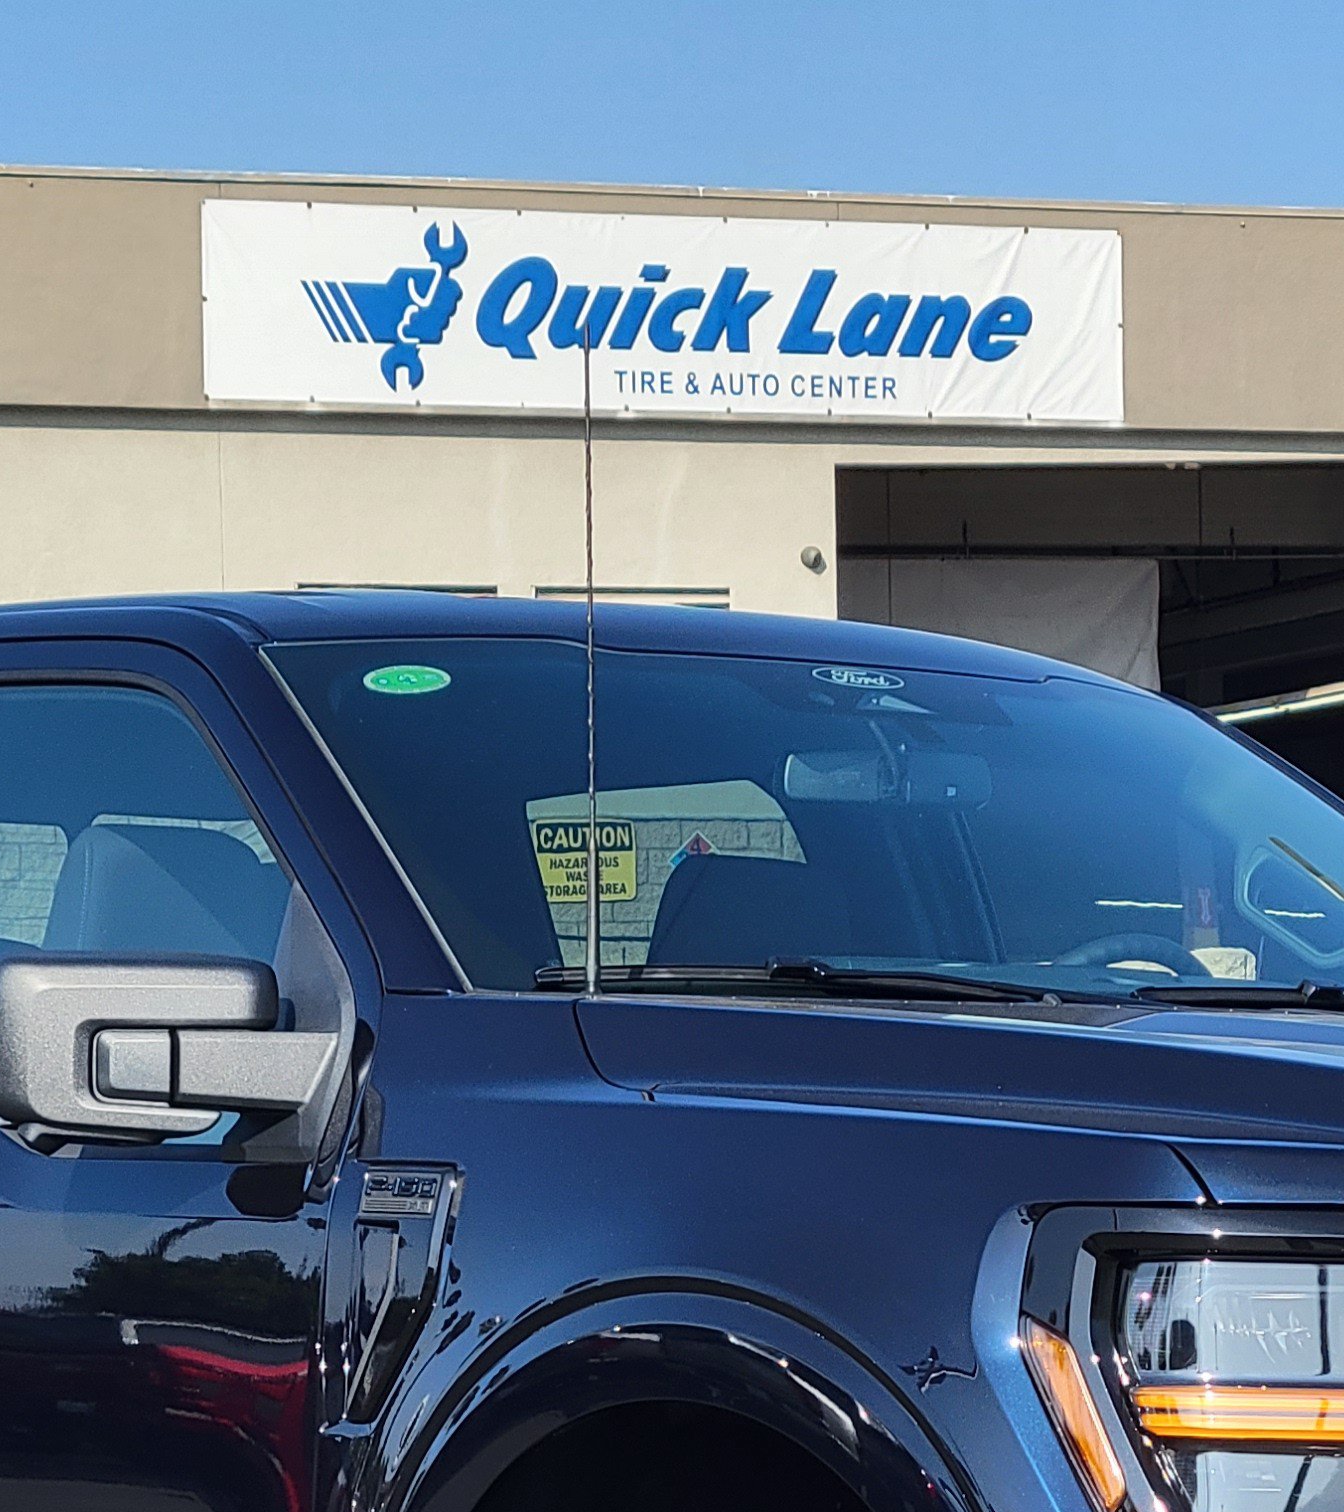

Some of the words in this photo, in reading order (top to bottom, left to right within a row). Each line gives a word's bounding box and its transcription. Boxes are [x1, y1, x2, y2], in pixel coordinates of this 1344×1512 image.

[476, 256, 773, 360] Quick
[777, 268, 1033, 362] Lane
[614, 370, 673, 395] TIRE
[685, 372, 700, 396] &
[711, 373, 780, 398] AUTO
[790, 375, 898, 400] CENTER
[831, 669, 889, 687] Ford
[549, 857, 619, 870] HAZAROUS
[565, 870, 603, 882] WASE
